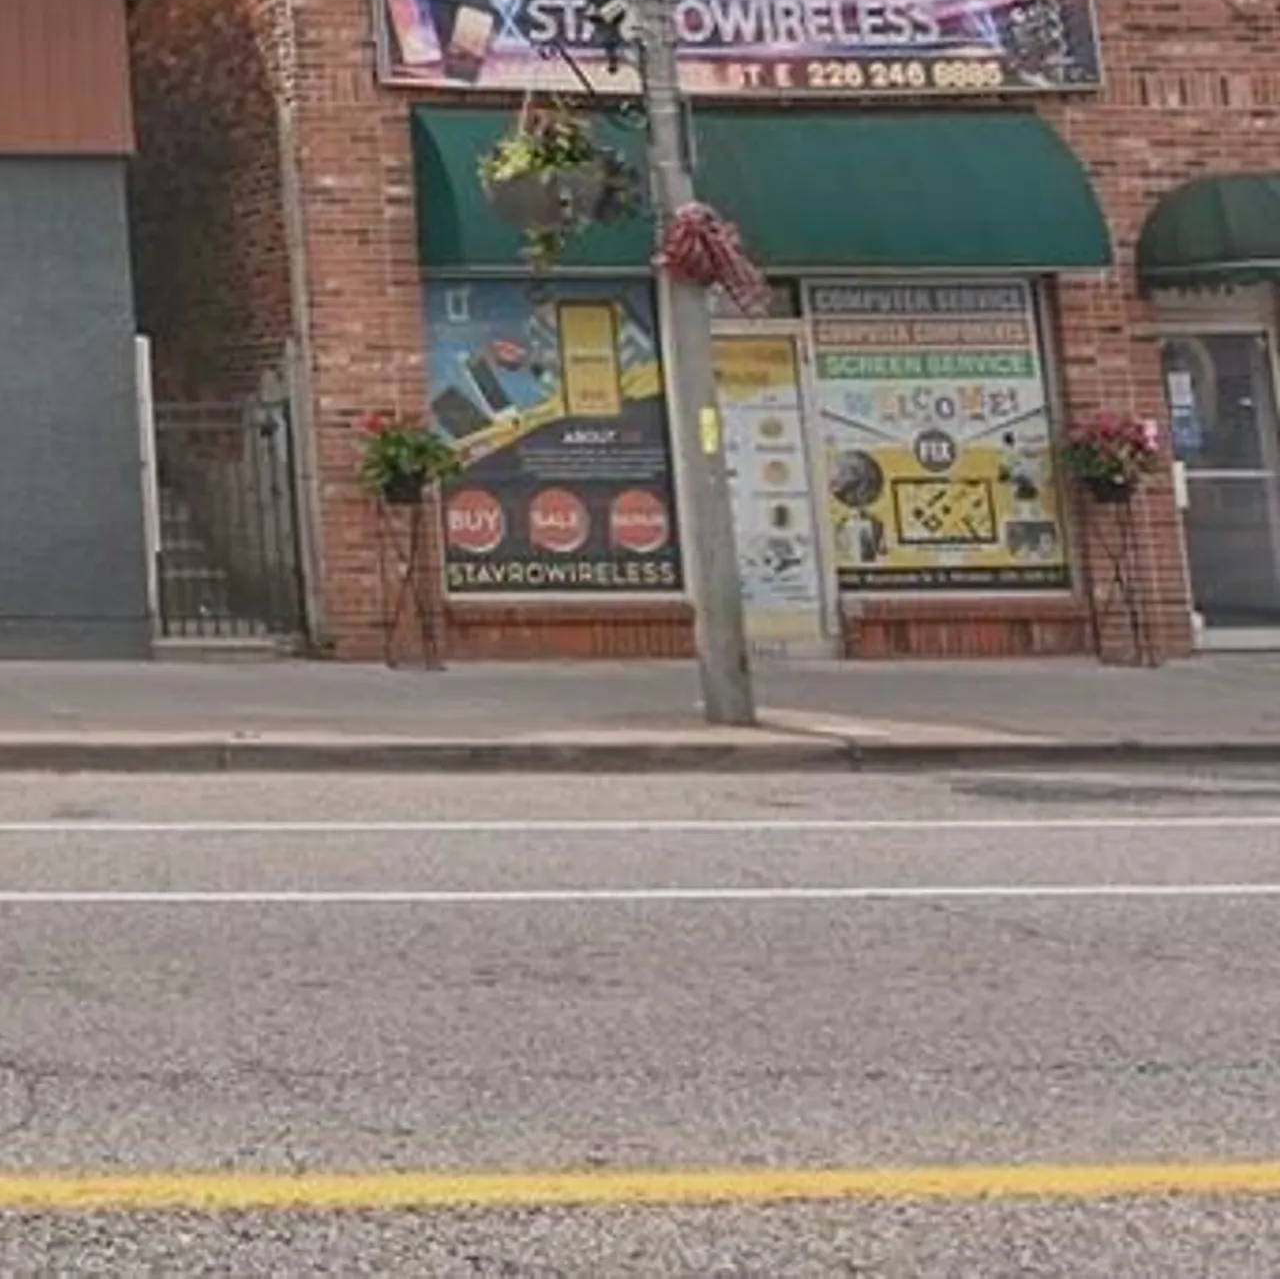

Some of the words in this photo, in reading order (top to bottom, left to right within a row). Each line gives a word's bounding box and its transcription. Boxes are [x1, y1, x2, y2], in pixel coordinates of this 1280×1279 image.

[814, 286, 930, 310] COMPUTER
[824, 353, 921, 377] SCREEN
[926, 353, 1029, 377] SERVICE
[561, 430, 618, 444] ABOUT
[447, 508, 500, 531] BUY
[446, 561, 677, 586] STAVROWIRELESS
